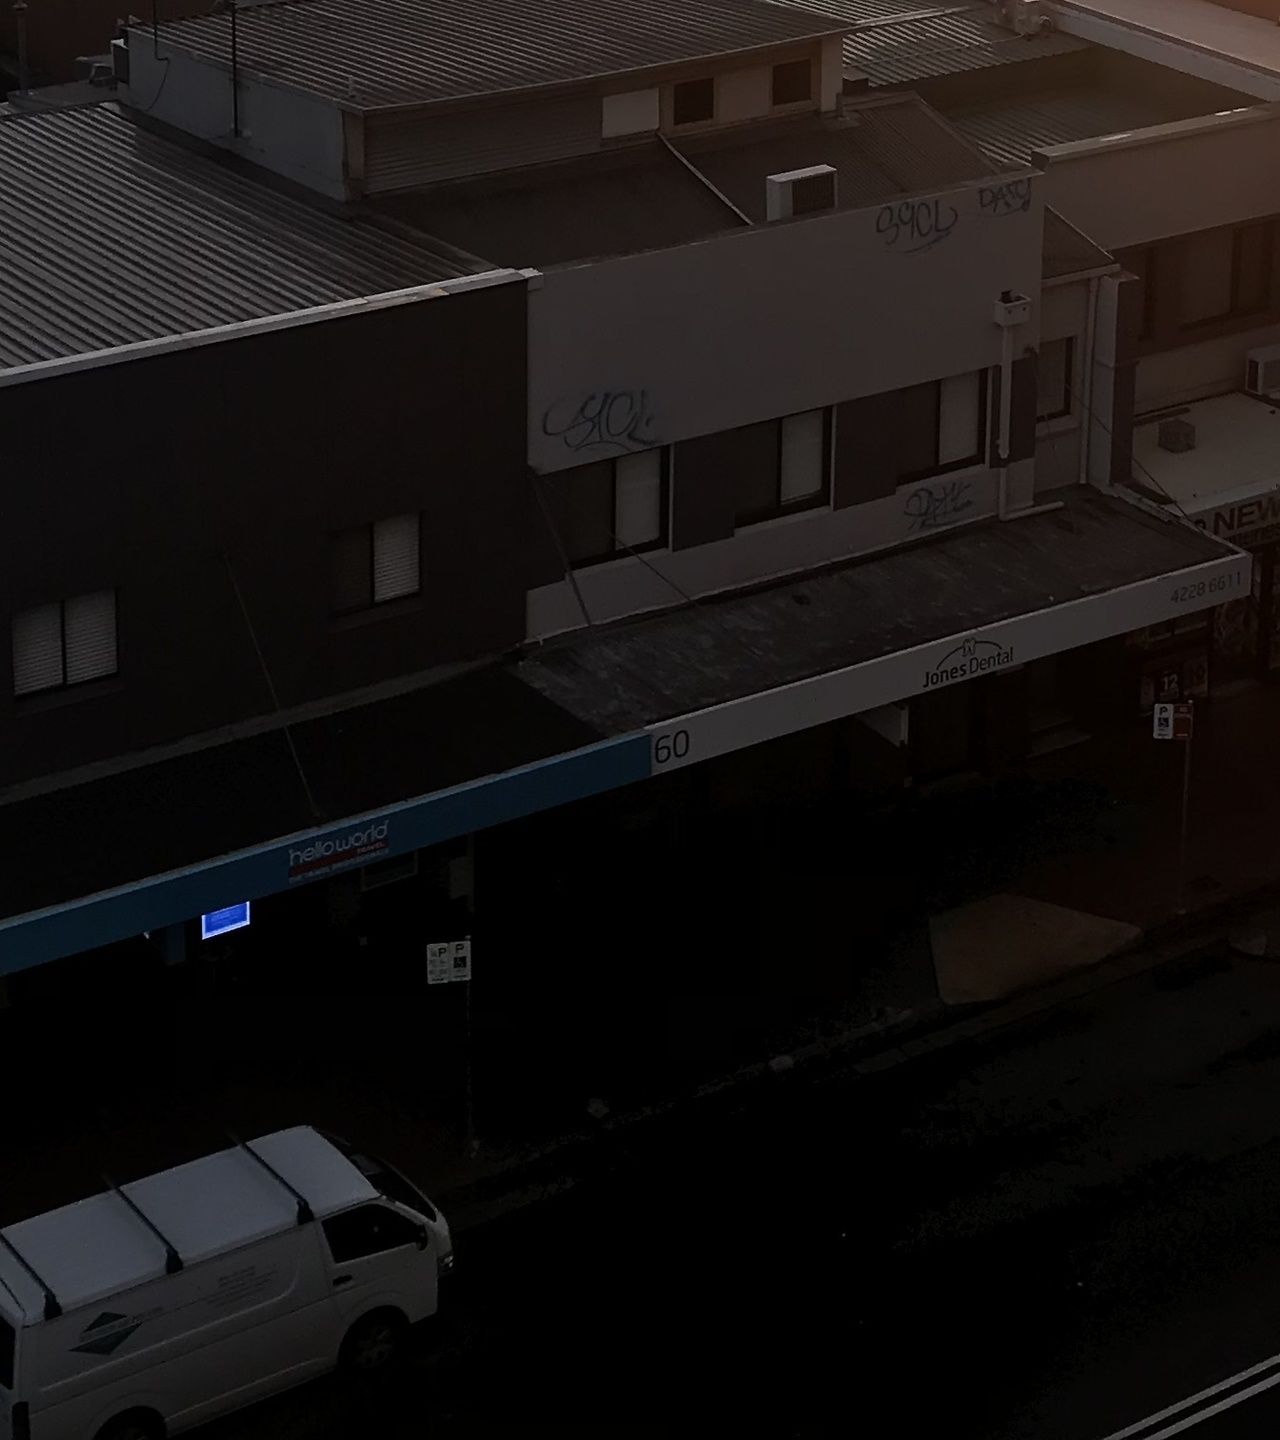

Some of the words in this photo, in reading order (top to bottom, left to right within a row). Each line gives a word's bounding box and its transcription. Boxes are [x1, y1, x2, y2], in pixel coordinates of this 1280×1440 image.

[1170, 581, 1206, 603] 4228
[922, 663, 967, 688] Jones
[968, 647, 1014, 674] Dental
[654, 729, 690, 764] 60
